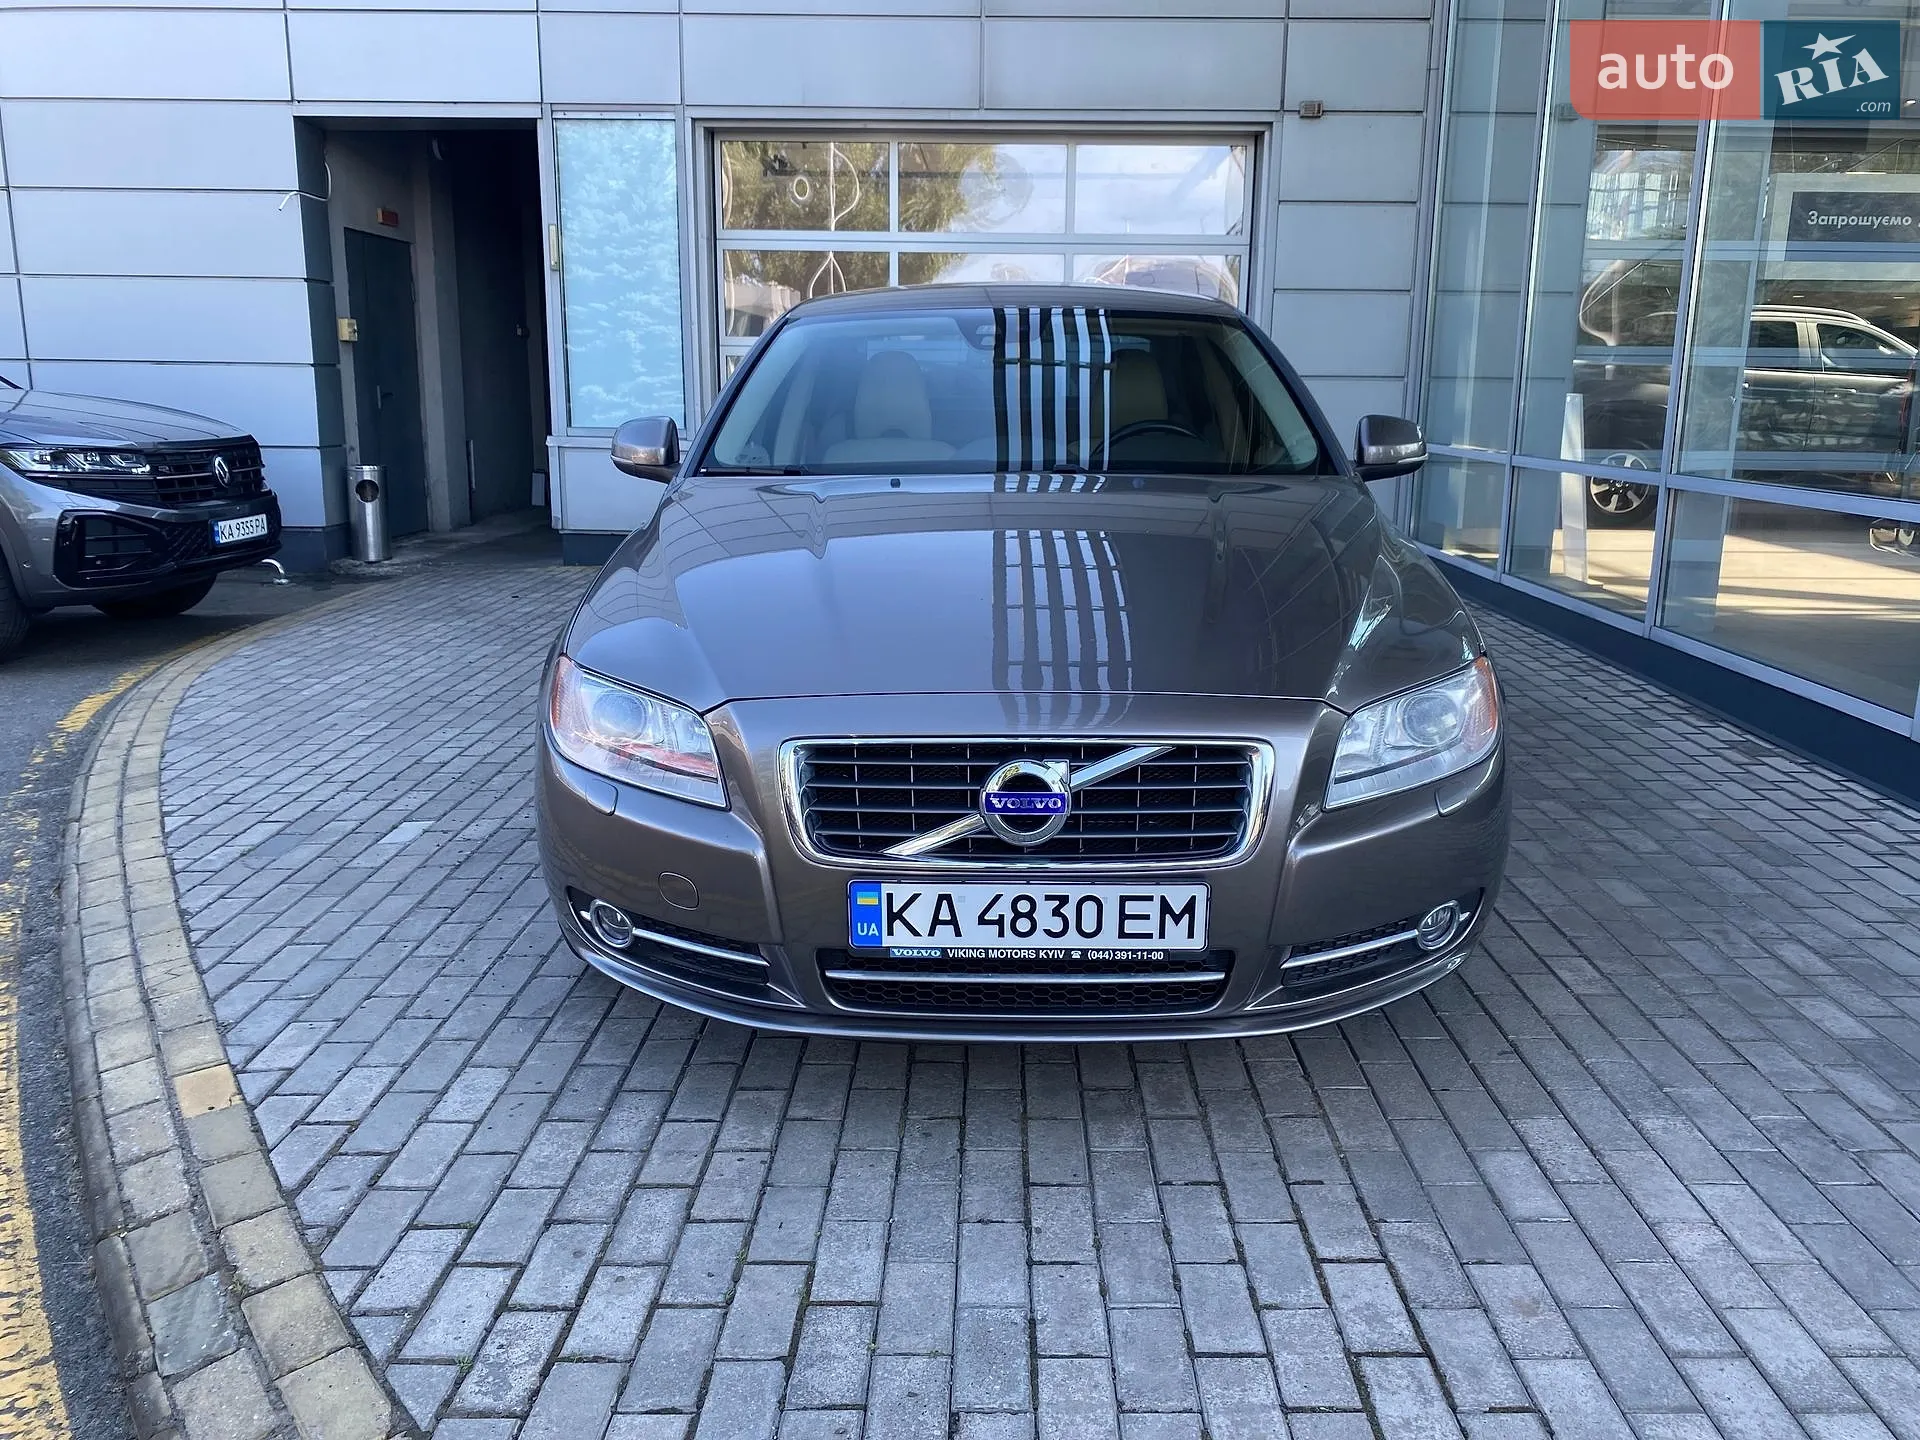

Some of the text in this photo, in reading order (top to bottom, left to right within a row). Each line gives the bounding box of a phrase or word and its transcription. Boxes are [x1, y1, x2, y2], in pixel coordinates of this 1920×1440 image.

[1807, 210, 1912, 229] Запрошуємо
[220, 524, 234, 540] KA
[255, 518, 266, 533] PA
[989, 796, 1062, 809] VOLVO
[885, 892, 1197, 941] KA 4830 EM
[857, 922, 879, 937] UA
[891, 948, 941, 958] VOLVO
[947, 948, 985, 959] VIKING
[988, 949, 1037, 959] MOTORS
[1039, 949, 1066, 960] KYIV
